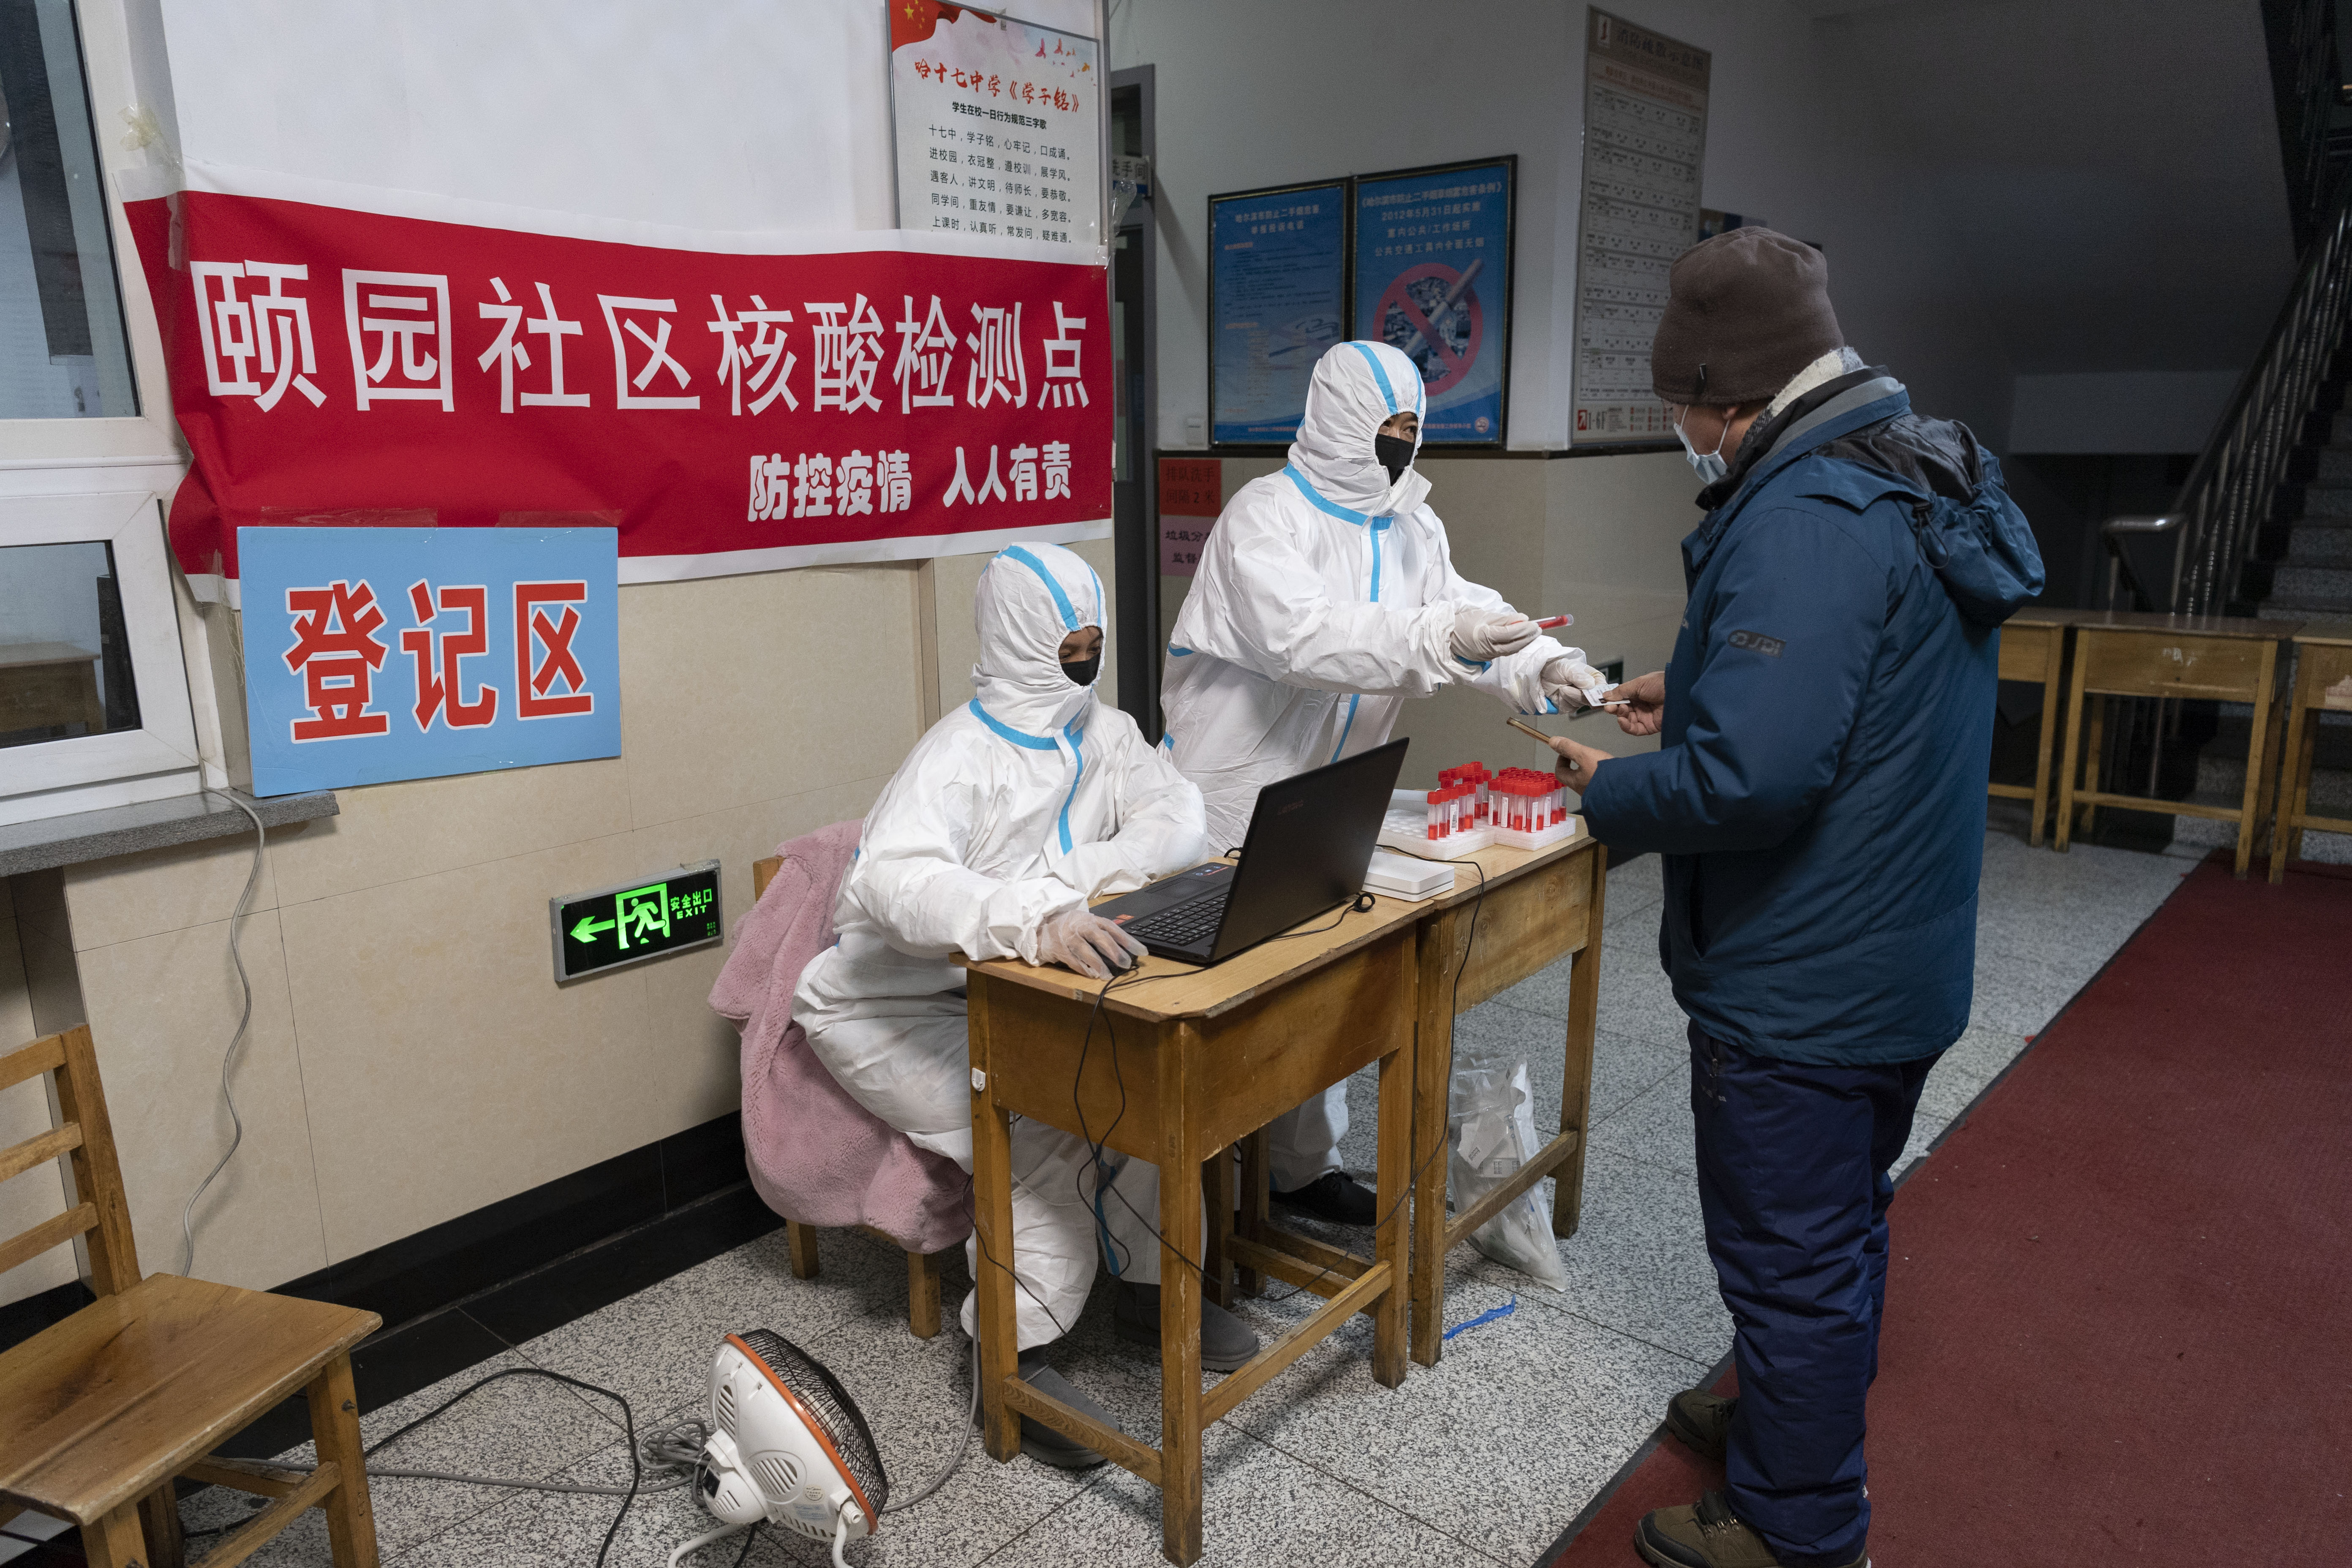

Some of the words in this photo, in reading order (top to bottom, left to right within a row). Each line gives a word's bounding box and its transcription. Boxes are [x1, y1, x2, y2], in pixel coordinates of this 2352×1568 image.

[915, 58, 1079, 112] 哈十七中学《学子铭》
[952, 101, 1047, 130] 学生在校一日行为规范三字歌
[190, 260, 1089, 416] 颐园社区核酸检测点
[748, 449, 912, 522] 防控疫情
[943, 441, 1071, 507] 人人有责
[1165, 467, 1215, 483] 排队洗手
[281, 578, 594, 743] 登记区
[670, 888, 712, 911] 安全出口
[677, 905, 707, 920] EXIT
